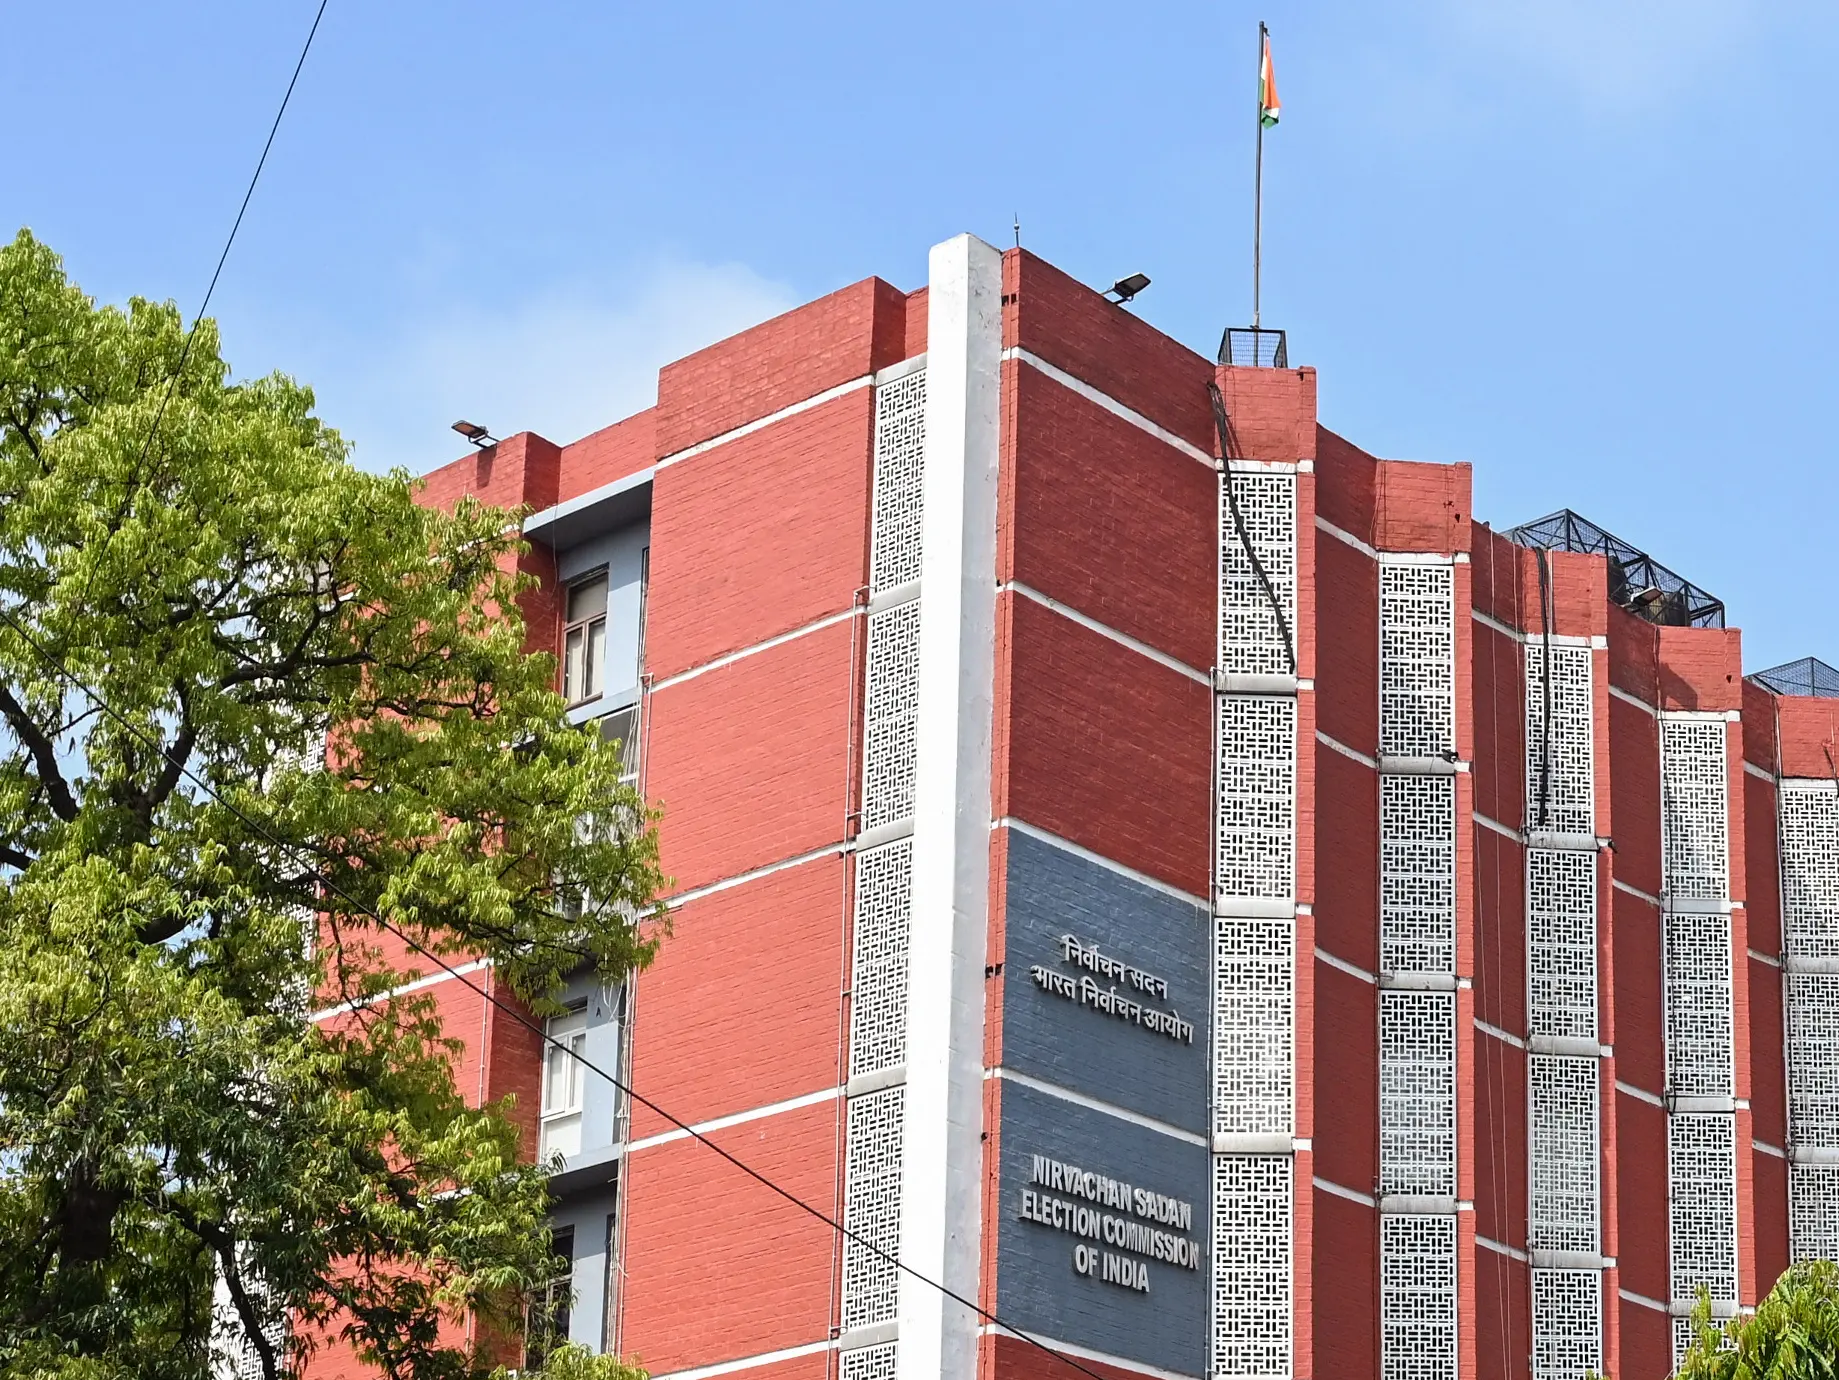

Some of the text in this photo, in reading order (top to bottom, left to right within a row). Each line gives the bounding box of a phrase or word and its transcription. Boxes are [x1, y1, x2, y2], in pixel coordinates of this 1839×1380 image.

[1031, 965, 1194, 1044] भारत निर्वाचन आयोग
[1060, 934, 1168, 1000] निर्वाचन सदन
[1021, 1189, 1200, 1270] ELECTION COMMISSION
[1032, 1154, 1192, 1231] NIRVACHAN SADAN
[1074, 1244, 1150, 1293] OF INDIA
